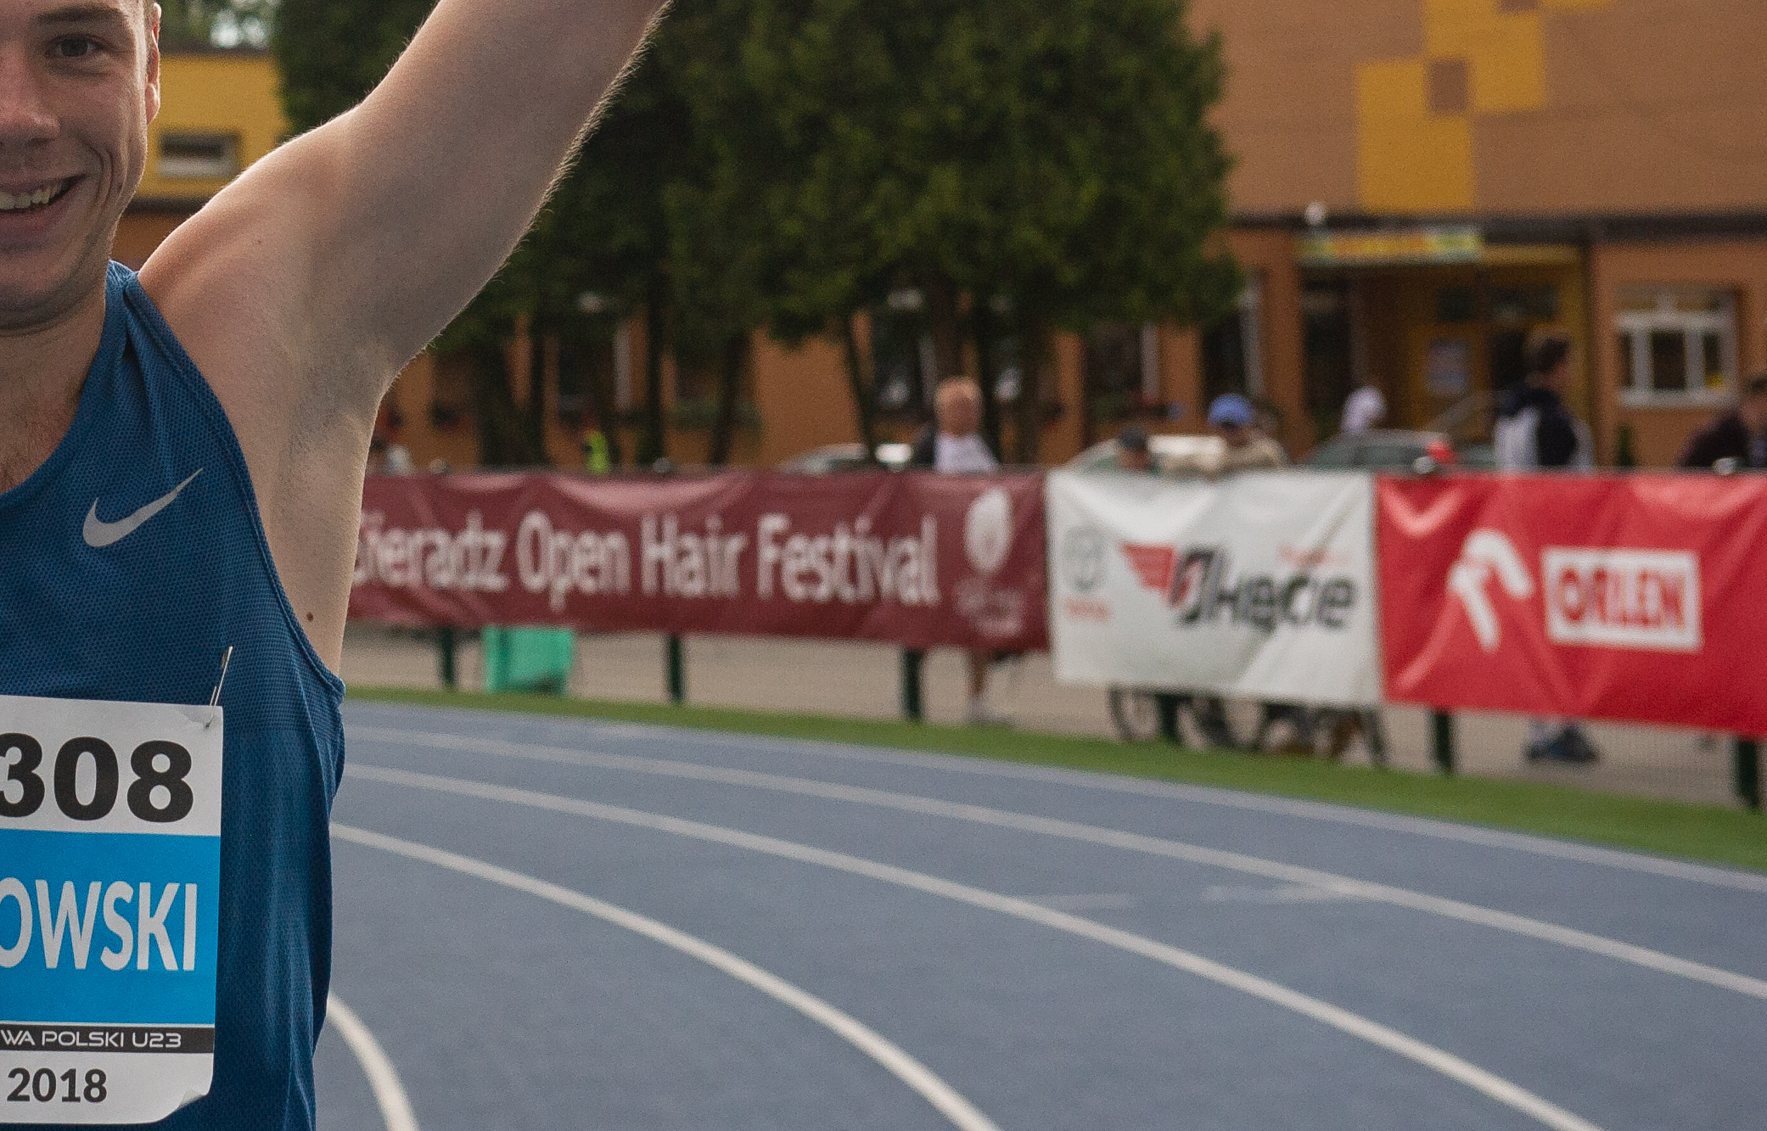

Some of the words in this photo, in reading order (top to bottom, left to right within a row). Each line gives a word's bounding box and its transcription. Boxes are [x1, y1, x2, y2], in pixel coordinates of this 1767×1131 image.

[516, 509, 630, 612] Open
[640, 514, 749, 599] Hair
[756, 513, 942, 606] Festival
[1558, 565, 1686, 632] ORLEN
[41, 1030, 124, 1048] POLSKI
[131, 1032, 182, 1049] U23
[6, 1067, 108, 1103] 2018
